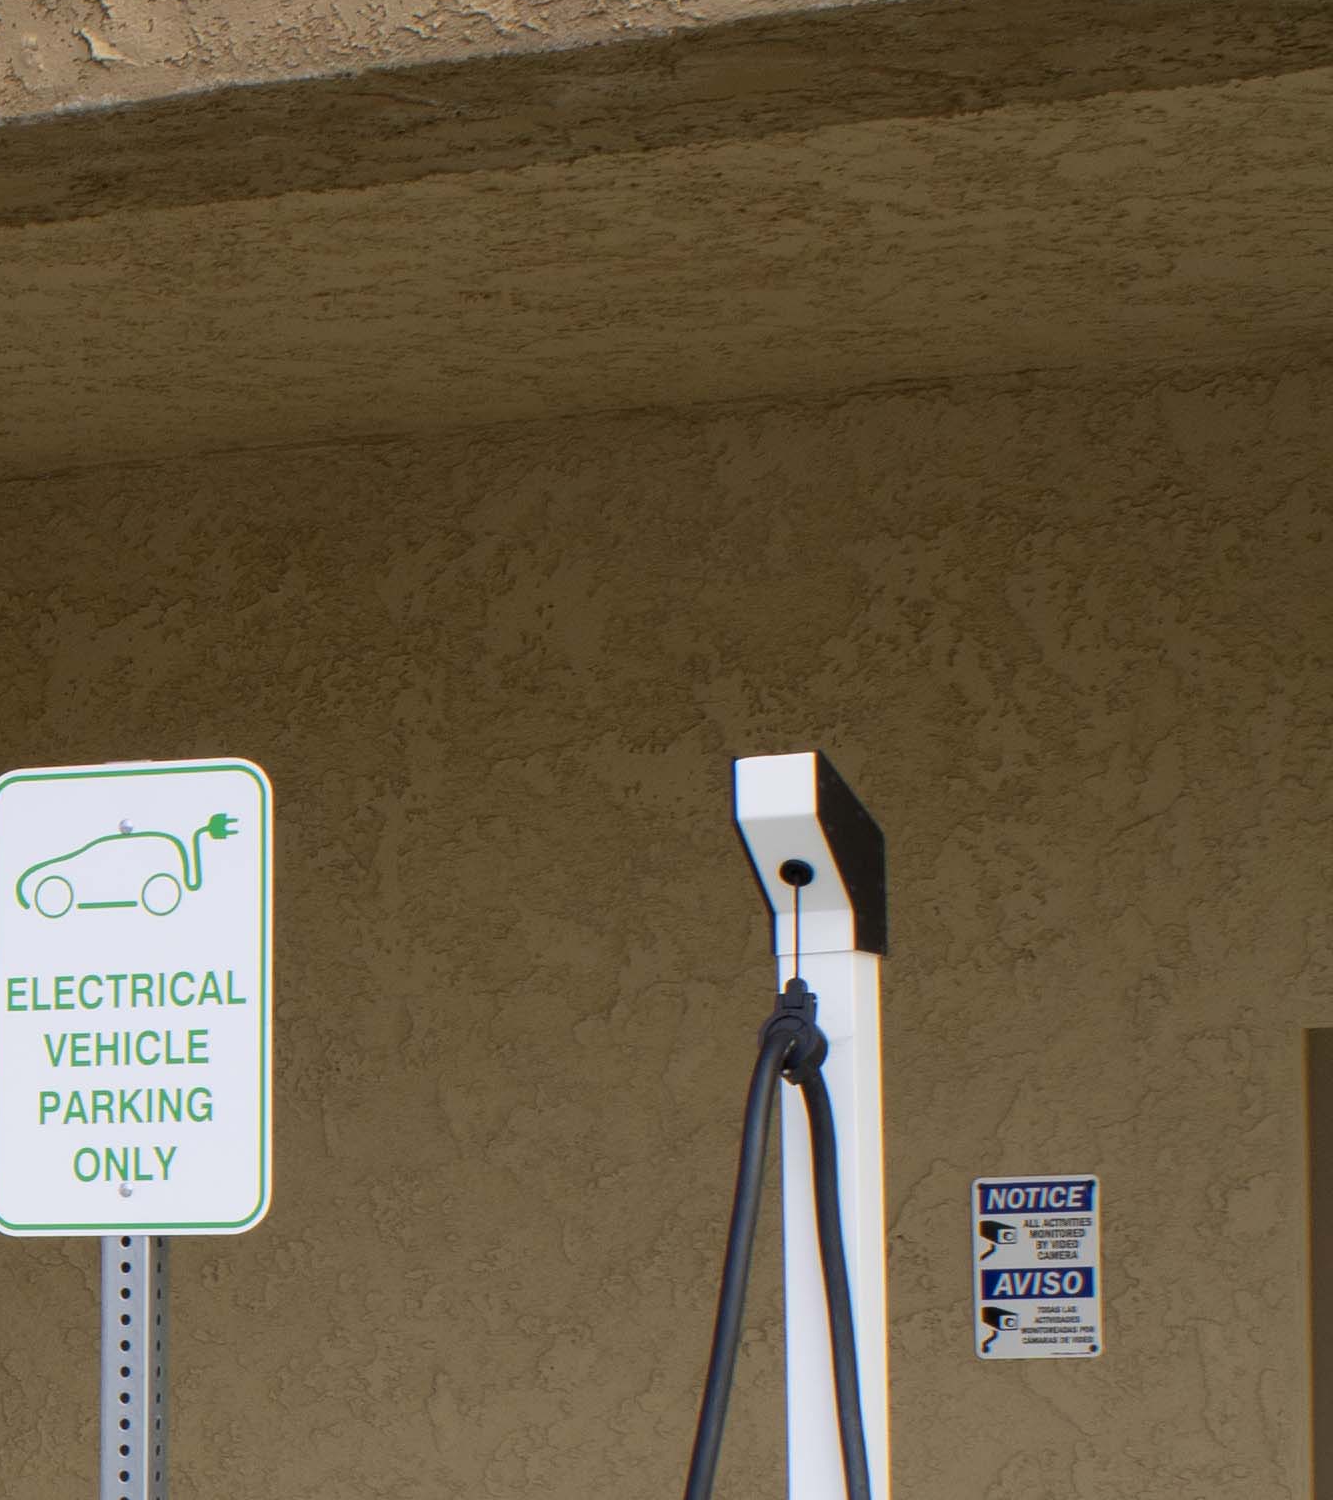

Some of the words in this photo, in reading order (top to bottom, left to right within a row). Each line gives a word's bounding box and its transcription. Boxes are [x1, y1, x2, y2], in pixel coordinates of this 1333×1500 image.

[6, 970, 247, 1011] ELECTRICAL
[43, 1029, 209, 1067] VEHICLE
[39, 1086, 213, 1125] PARKING
[73, 1146, 177, 1182] ONLY
[987, 1186, 1085, 1210] NOTICE
[1030, 1229, 1085, 1238] MONITORED
[1037, 1251, 1078, 1260] CAMERA
[992, 1271, 1083, 1296] AVISO
